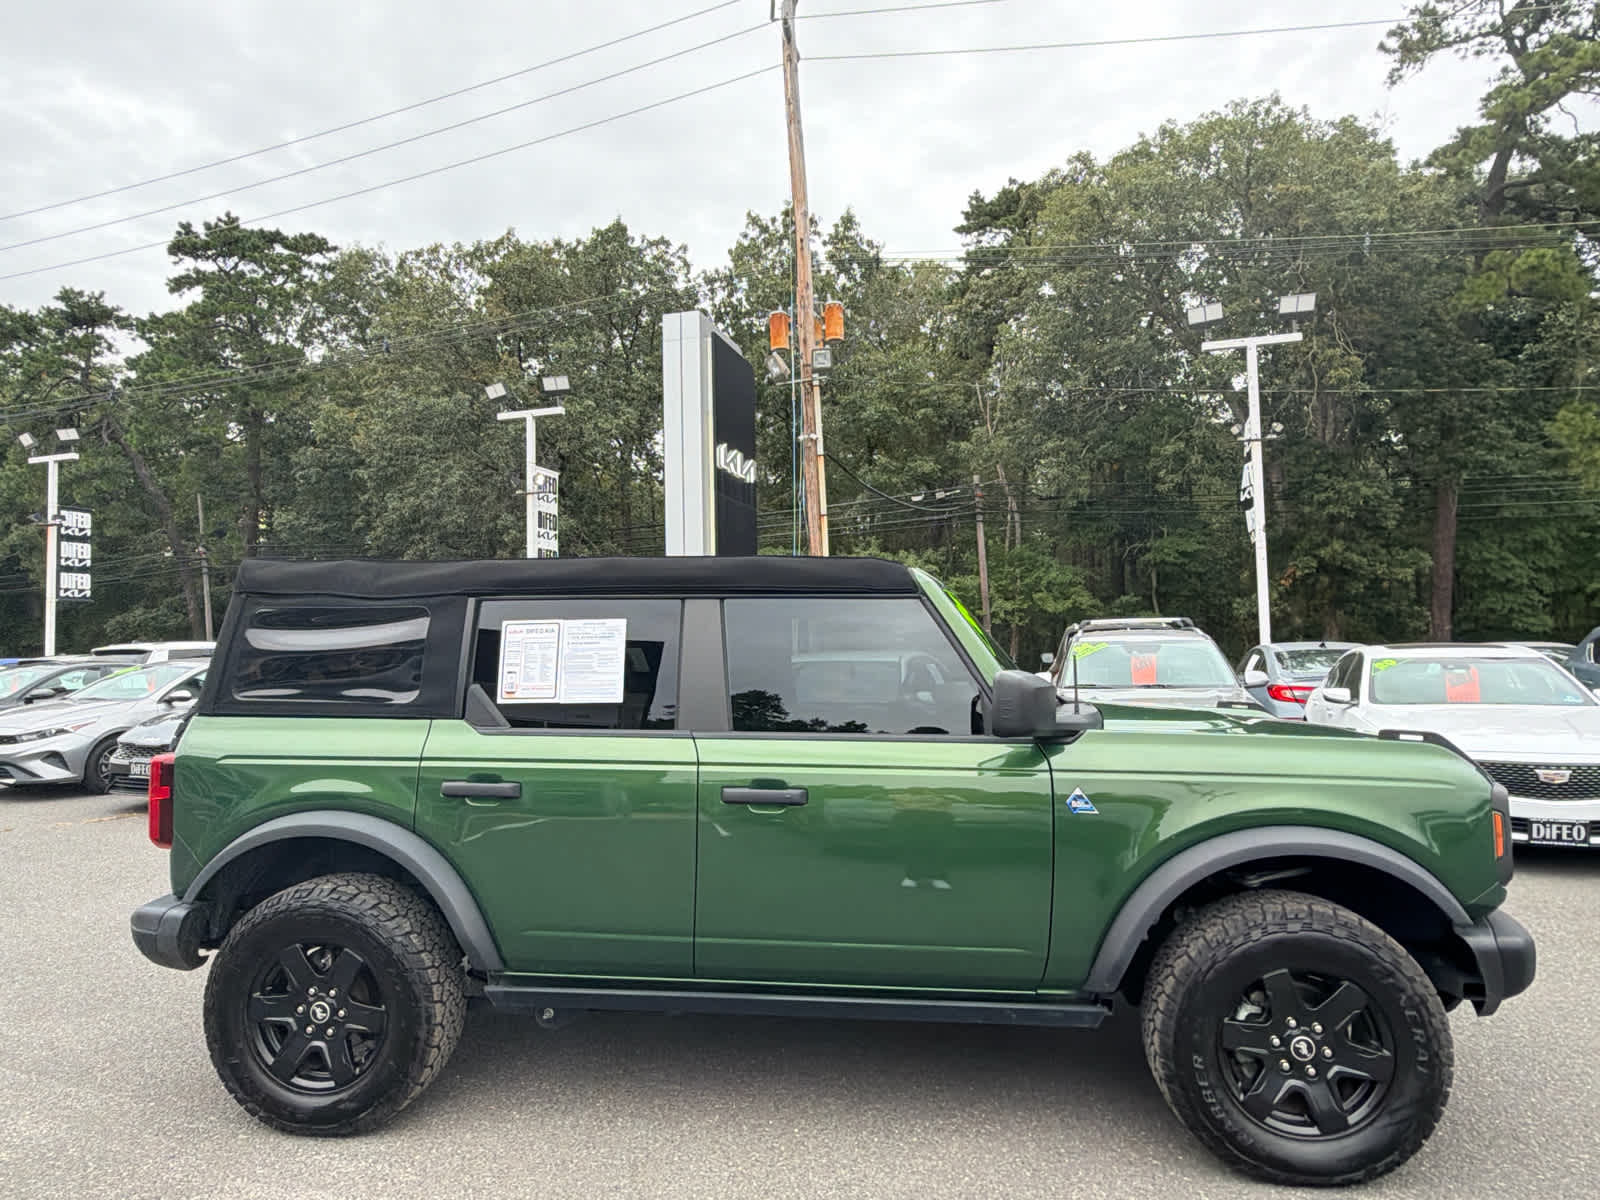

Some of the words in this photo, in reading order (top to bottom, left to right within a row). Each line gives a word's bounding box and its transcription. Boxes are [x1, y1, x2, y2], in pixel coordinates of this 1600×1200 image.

[716, 443, 757, 483] KIA
[60, 527, 91, 536] KIA
[60, 558, 91, 567] KIA
[60, 588, 91, 597] KIA
[1532, 823, 1586, 841] DiFEO
